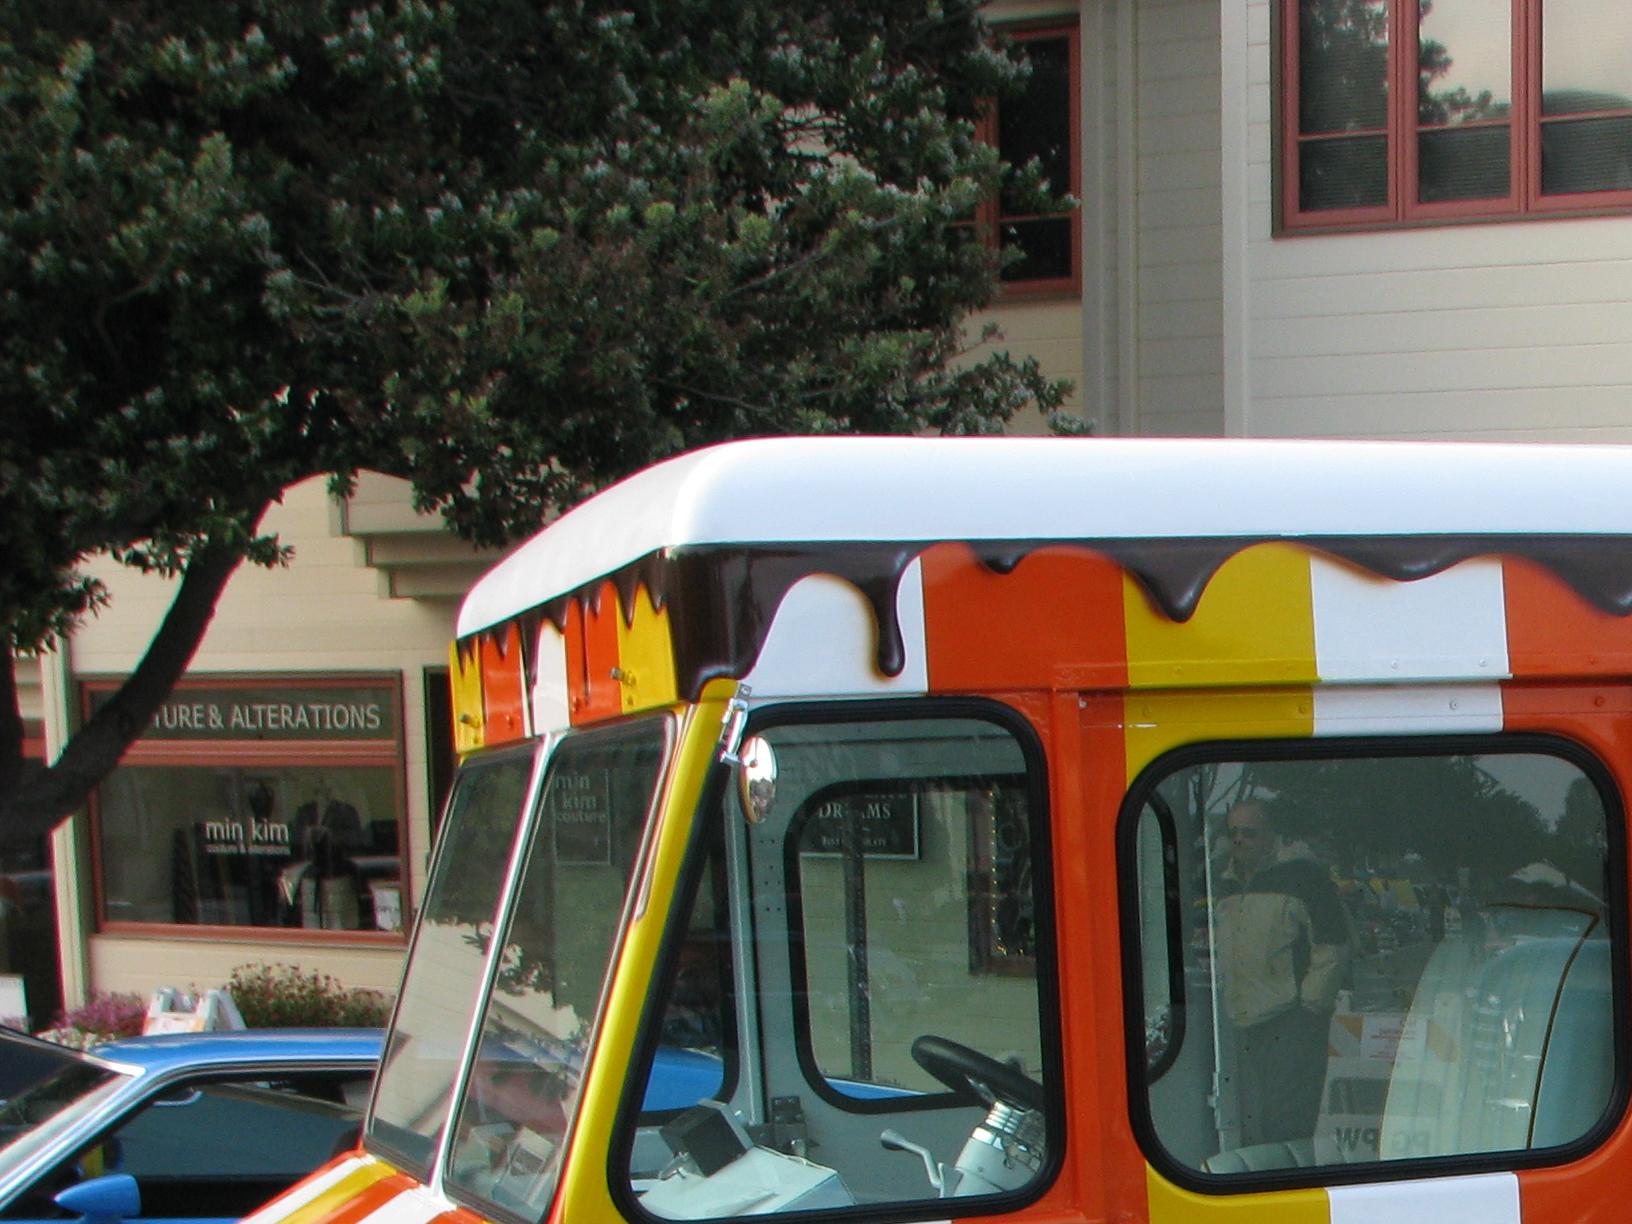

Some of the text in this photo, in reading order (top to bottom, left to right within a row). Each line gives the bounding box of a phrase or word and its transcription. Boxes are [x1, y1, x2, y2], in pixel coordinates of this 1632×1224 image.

[206, 704, 225, 729] &
[230, 704, 382, 729] ALTERATIONS
[818, 801, 892, 819] DRMS
[205, 817, 289, 842] min kim
